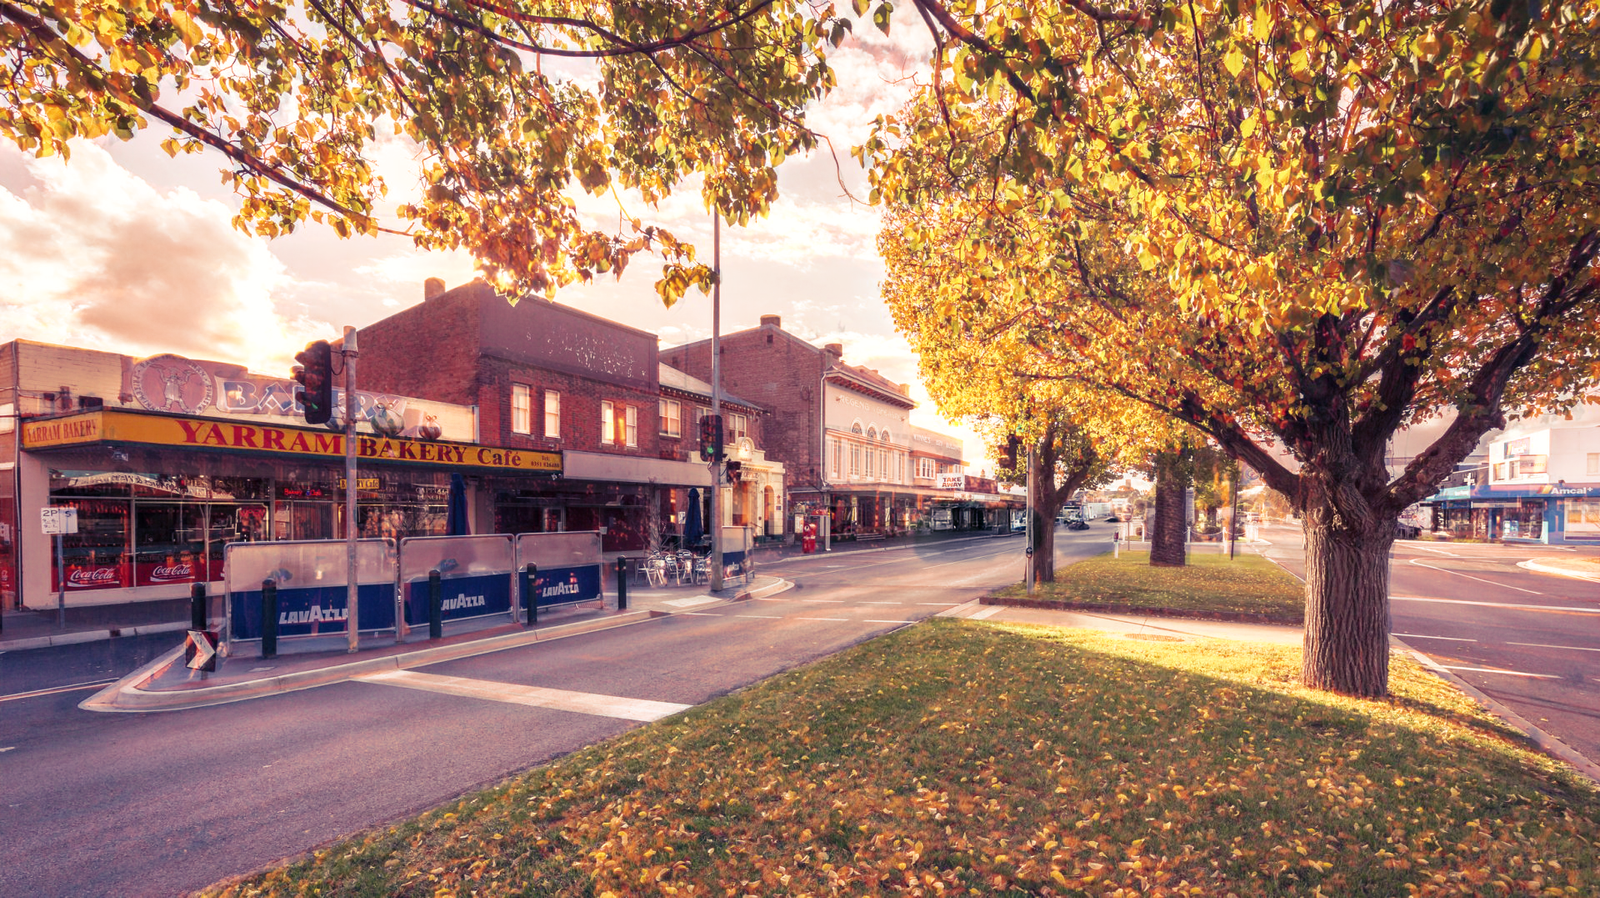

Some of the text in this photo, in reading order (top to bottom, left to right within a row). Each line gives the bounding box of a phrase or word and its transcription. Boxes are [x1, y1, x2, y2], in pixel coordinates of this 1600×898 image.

[27, 419, 98, 443] YARRAM BAKERY
[174, 420, 522, 467] YARRAM BAKERY Café
[43, 509, 58, 517] 2P
[542, 581, 580, 598] LAVAZZA
[440, 593, 486, 611] AVAZZA
